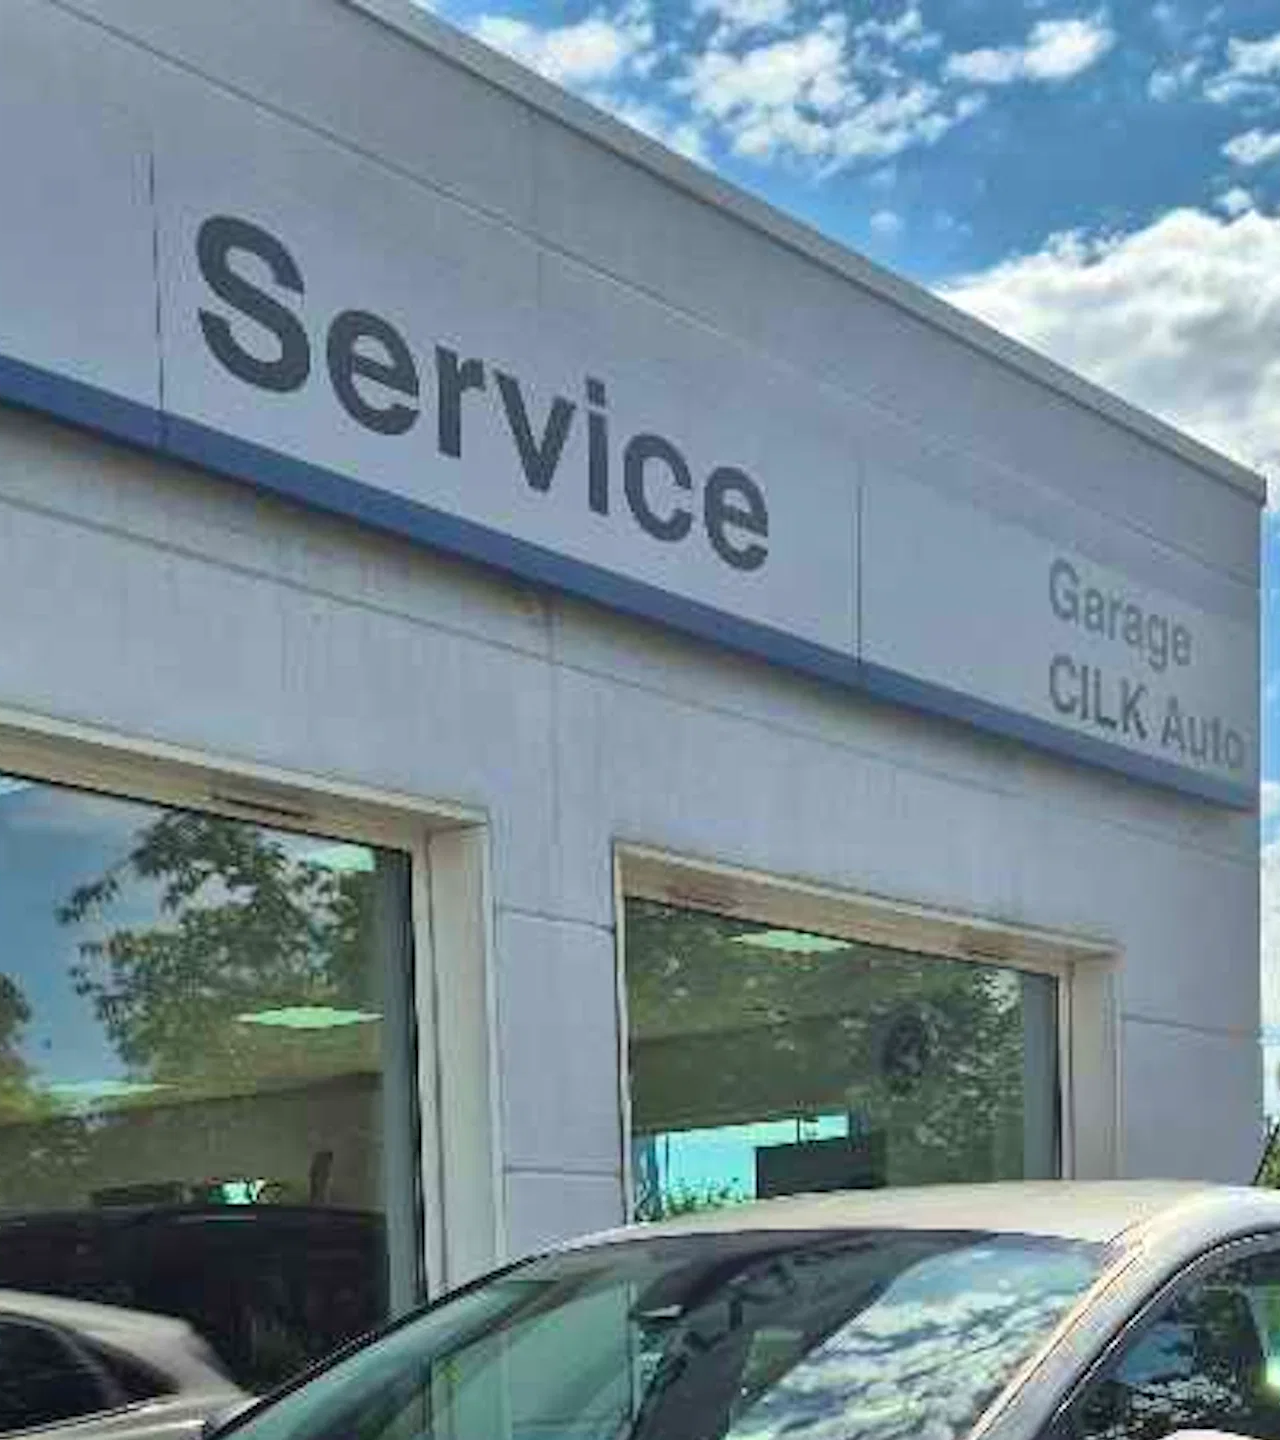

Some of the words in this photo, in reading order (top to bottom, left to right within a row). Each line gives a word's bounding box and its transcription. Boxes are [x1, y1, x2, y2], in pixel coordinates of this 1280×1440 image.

[195, 213, 769, 572] Service
[1048, 557, 1194, 673] Garage
[1048, 653, 1148, 740] CILK
[1160, 694, 1246, 769] Auto
